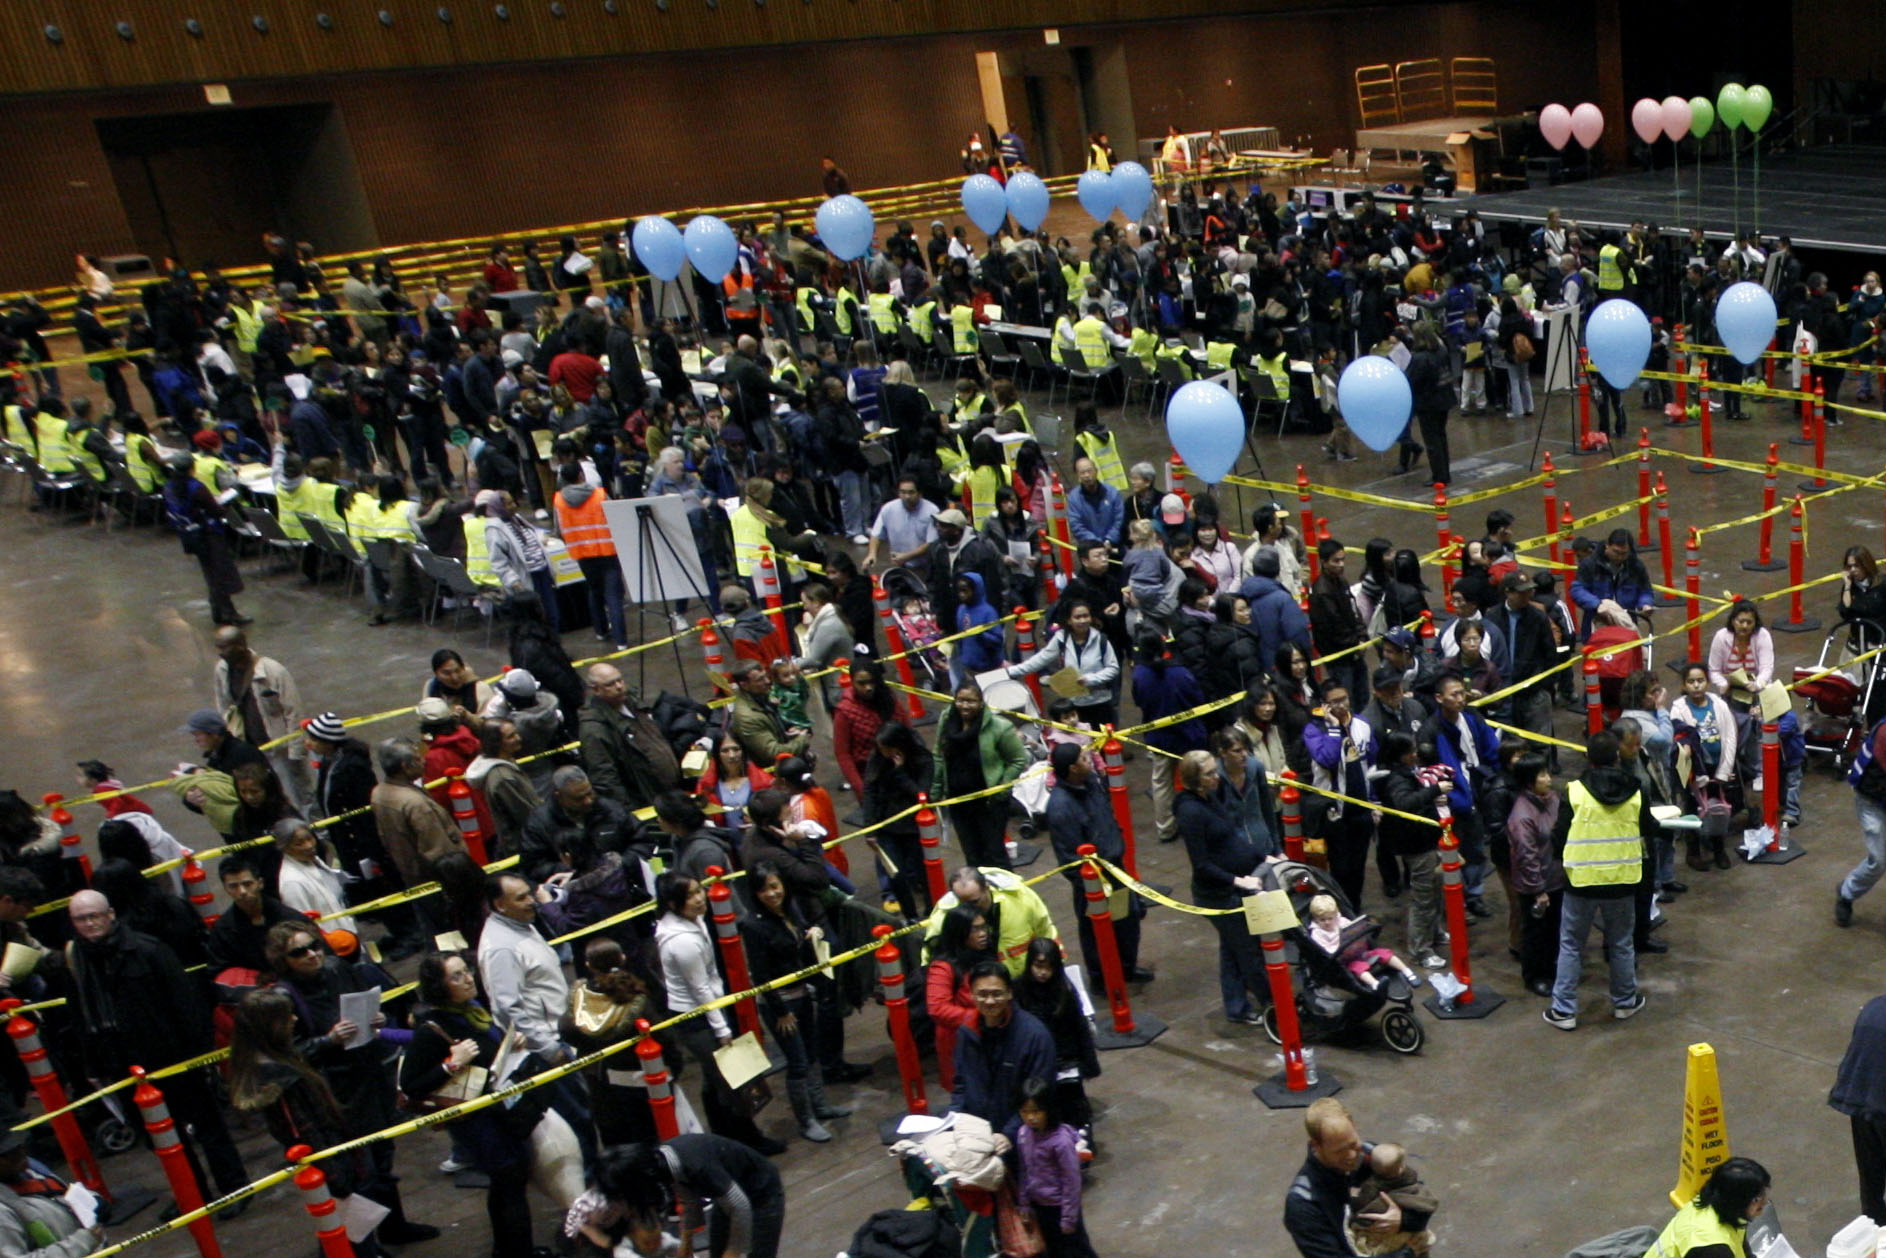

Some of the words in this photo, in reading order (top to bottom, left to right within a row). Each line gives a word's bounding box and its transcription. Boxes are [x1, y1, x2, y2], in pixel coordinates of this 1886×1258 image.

[1704, 1130, 1719, 1139] WET
[1701, 1139, 1723, 1151] FLOOR
[1705, 1155, 1721, 1165] PISO
